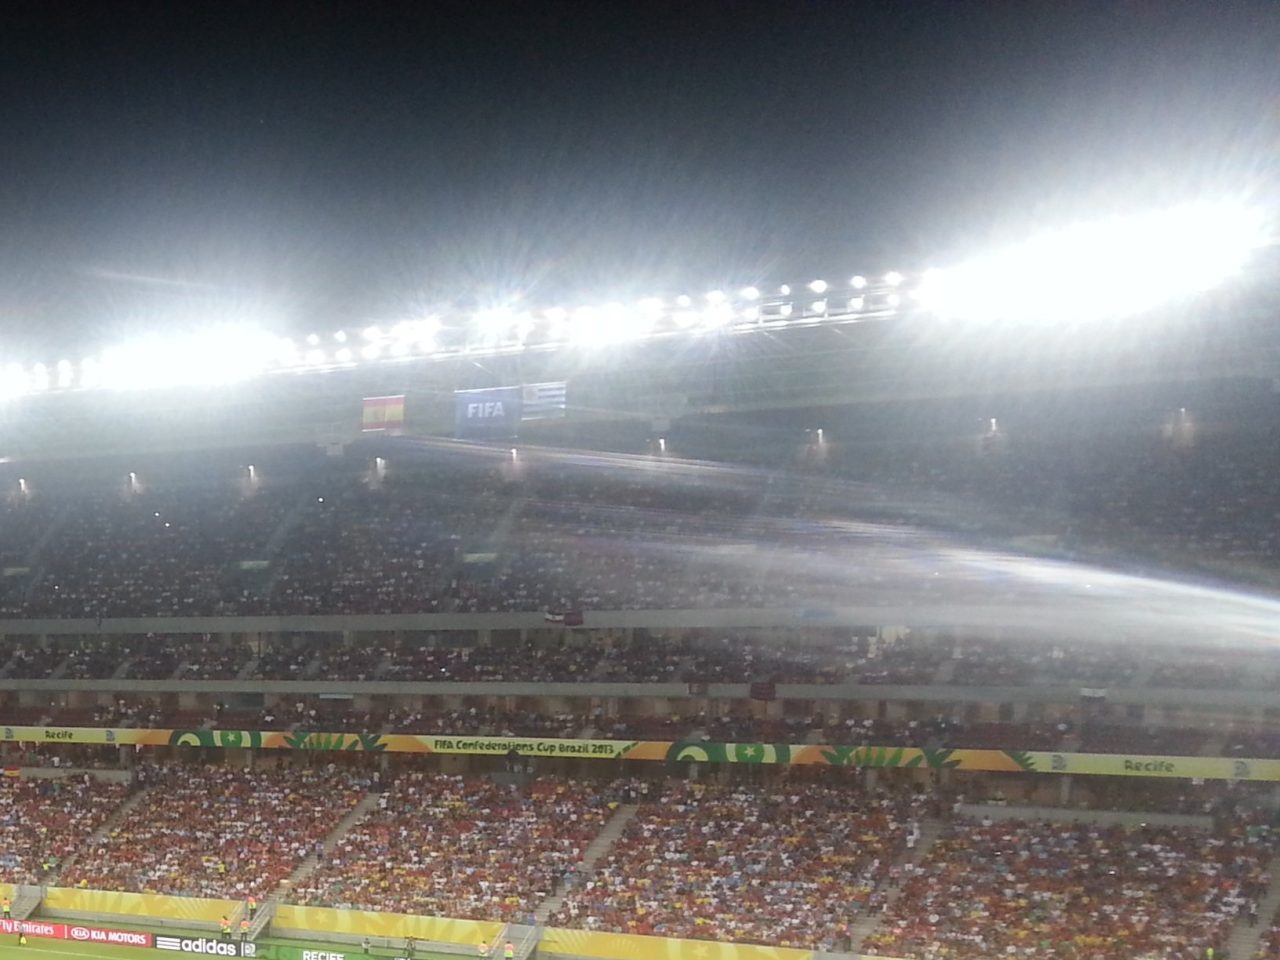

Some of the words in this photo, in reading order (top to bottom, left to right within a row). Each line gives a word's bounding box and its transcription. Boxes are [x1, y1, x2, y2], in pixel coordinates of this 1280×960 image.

[467, 402, 505, 418] FIFA
[44, 729, 73, 740] Recife
[434, 739, 454, 750] FIFA
[456, 739, 534, 753] Confederations
[536, 742, 557, 755] Cup
[559, 743, 589, 754] Brazil
[591, 744, 615, 754] 2013
[1124, 759, 1175, 773] Recife
[14, 922, 54, 936] Emirates
[91, 930, 106, 940] KIA
[108, 932, 146, 945] MOTORS
[181, 937, 236, 957] adidas
